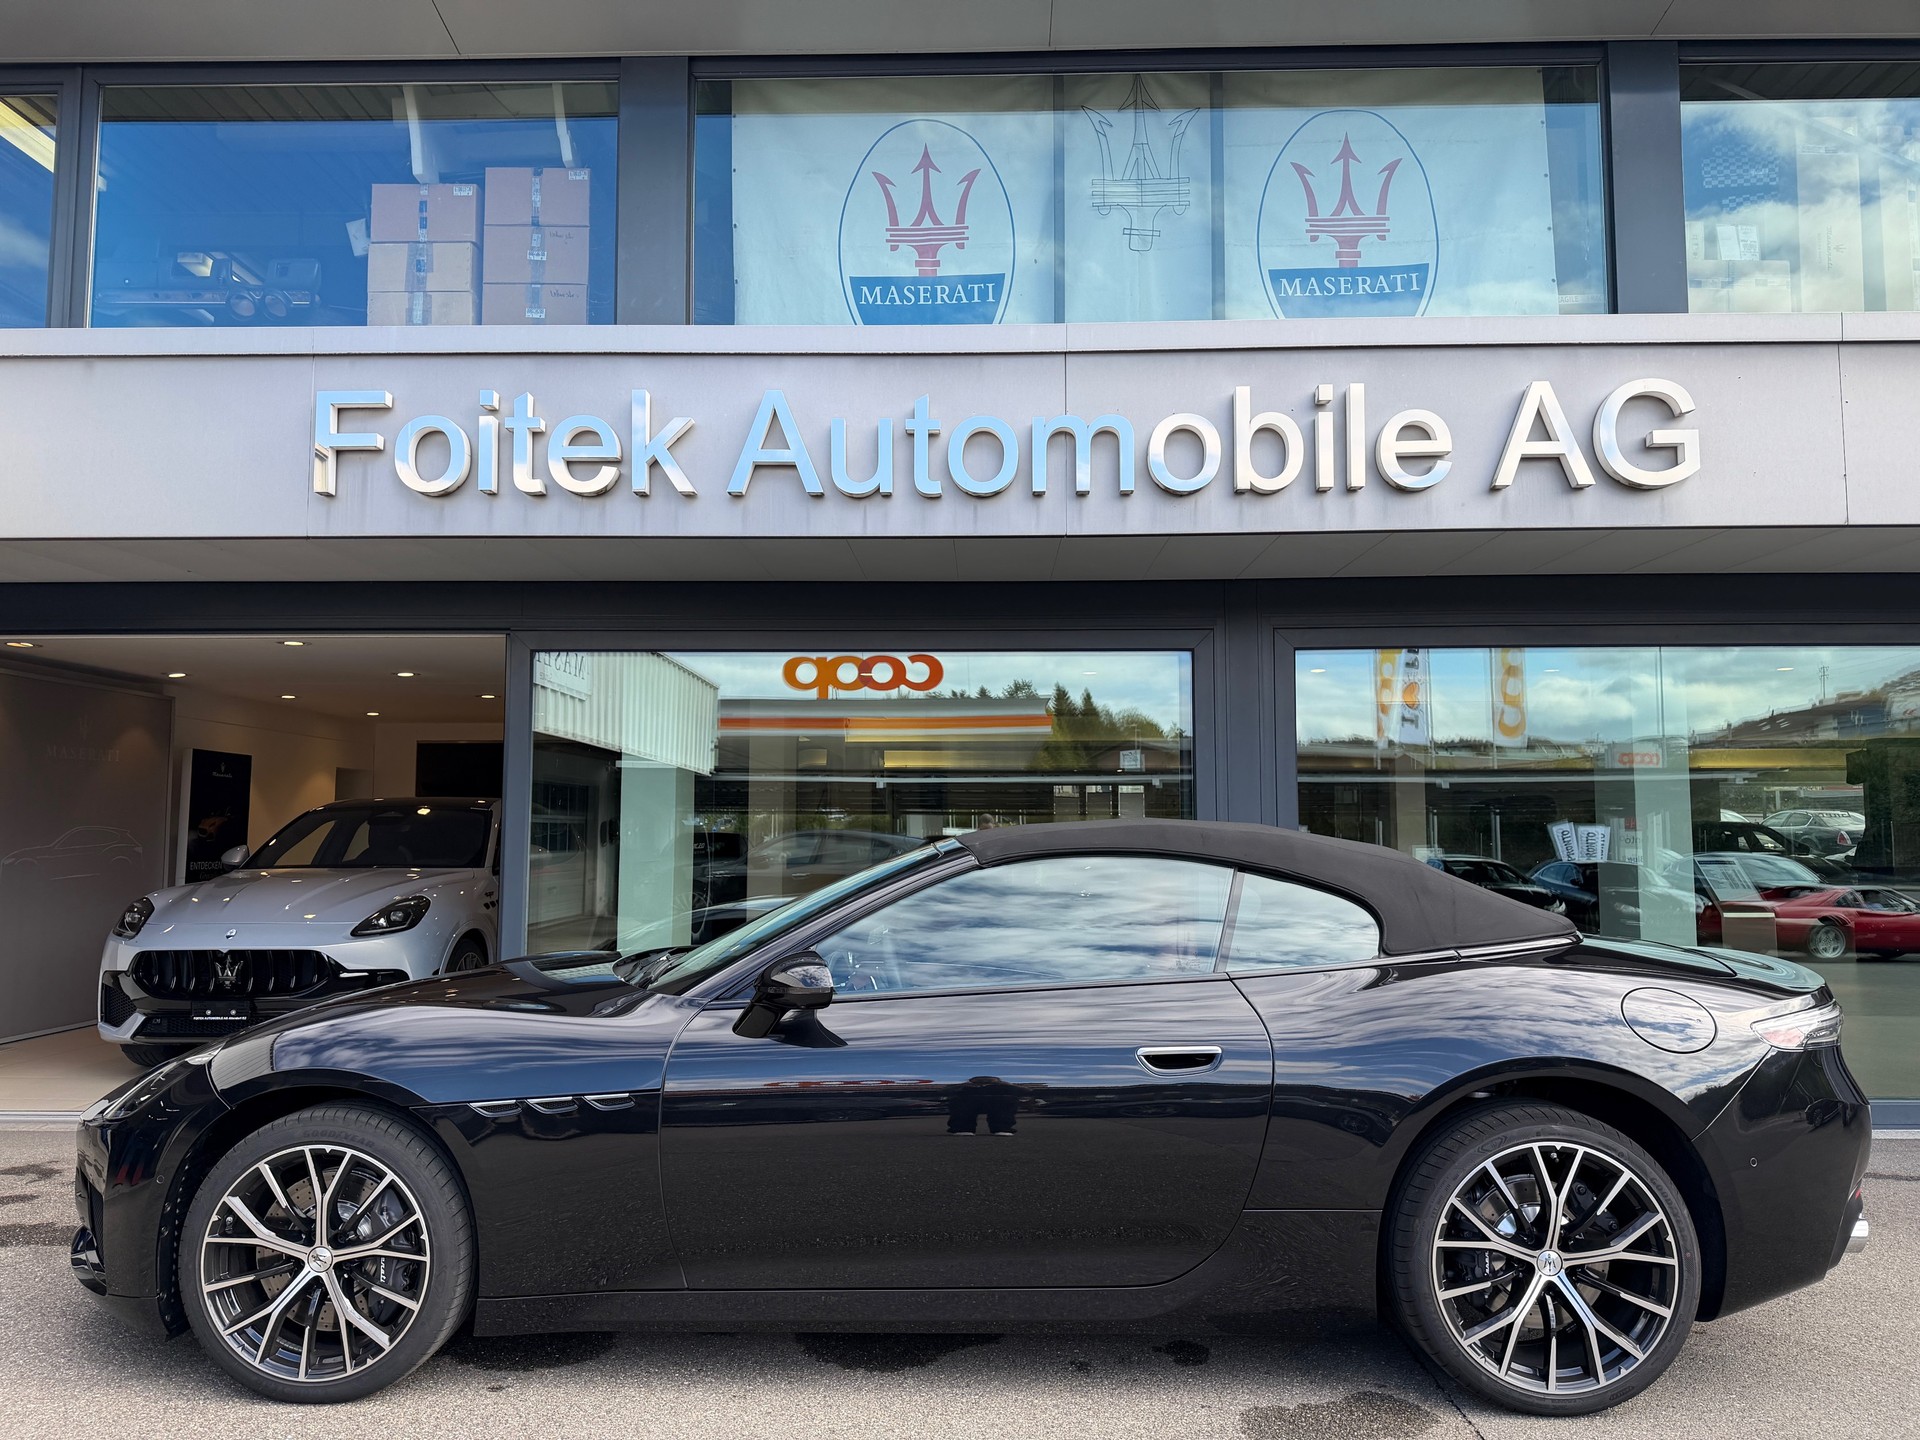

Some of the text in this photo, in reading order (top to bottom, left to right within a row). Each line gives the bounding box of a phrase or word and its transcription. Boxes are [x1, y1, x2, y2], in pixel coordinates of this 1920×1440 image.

[859, 281, 996, 306] MASERATI
[1278, 271, 1421, 298] MASERATI
[312, 377, 1701, 498] Foitek Automobile AG
[1585, 831, 1597, 861] RONTO
[303, 1129, 376, 1149] GOODYEAR
